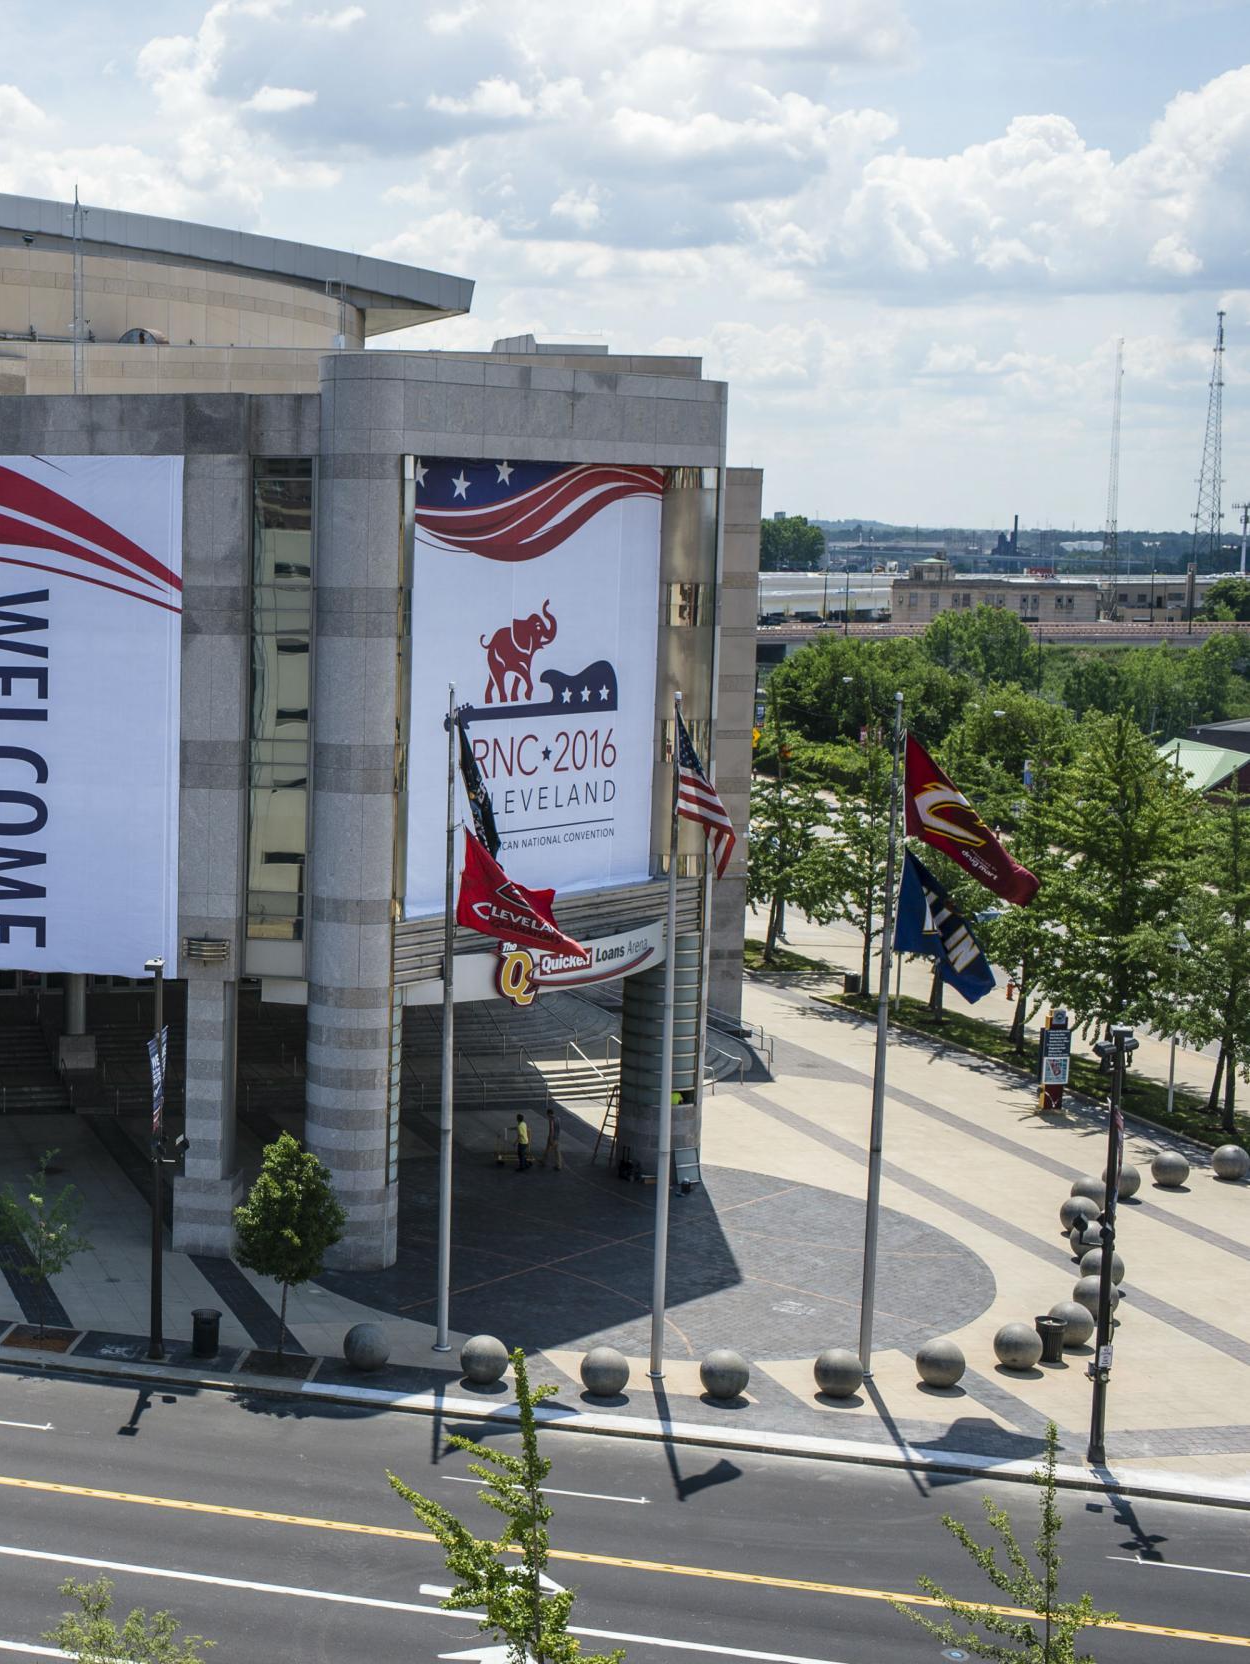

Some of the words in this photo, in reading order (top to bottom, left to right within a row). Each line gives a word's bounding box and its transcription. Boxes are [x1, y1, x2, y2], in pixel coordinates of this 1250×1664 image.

[472, 734, 539, 780] RNC
[553, 727, 617, 773] 2016
[490, 779, 617, 816] LEVELAND
[521, 834, 562, 851] NATIONAL
[563, 827, 615, 844] CONVENTION
[502, 941, 517, 953] The
[596, 945, 625, 963] Loans
[626, 938, 648, 956] Arena
[501, 950, 536, 1007] Q
